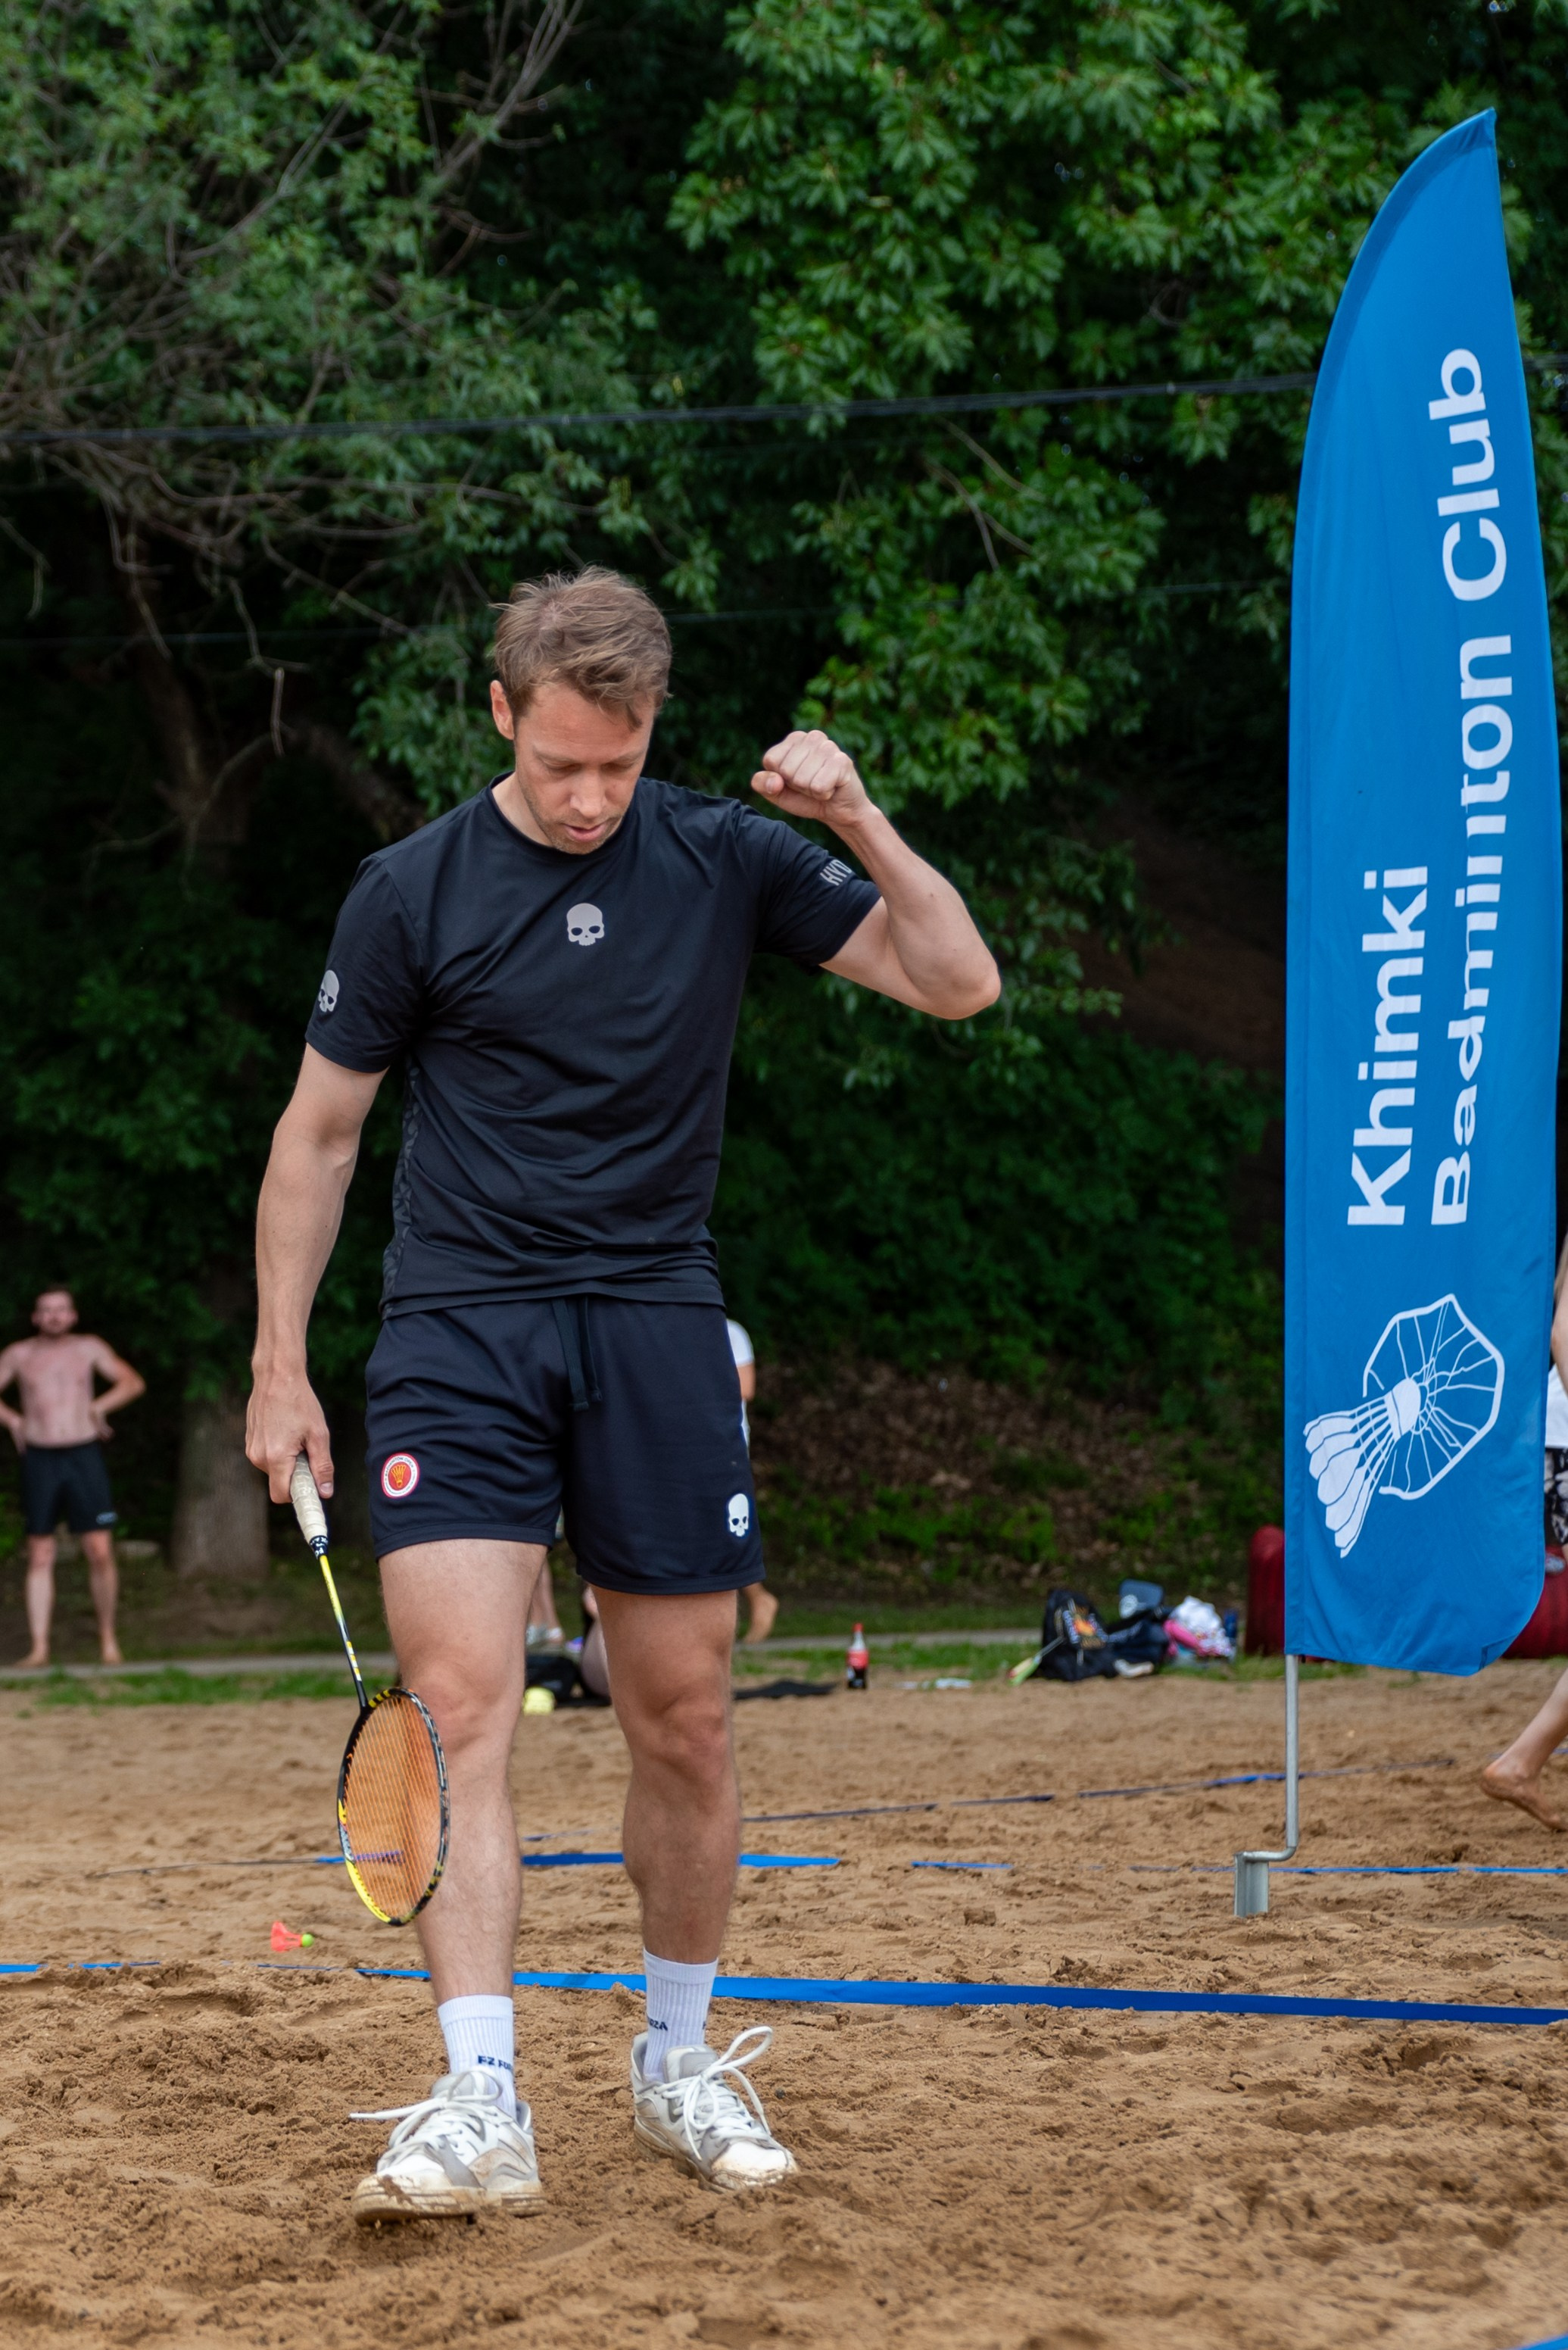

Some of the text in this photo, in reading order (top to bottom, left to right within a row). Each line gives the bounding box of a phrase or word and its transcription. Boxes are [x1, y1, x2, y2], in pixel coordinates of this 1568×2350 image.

[1348, 866, 1428, 1225] Khimki
[1429, 348, 1513, 1225] Badminton Club
